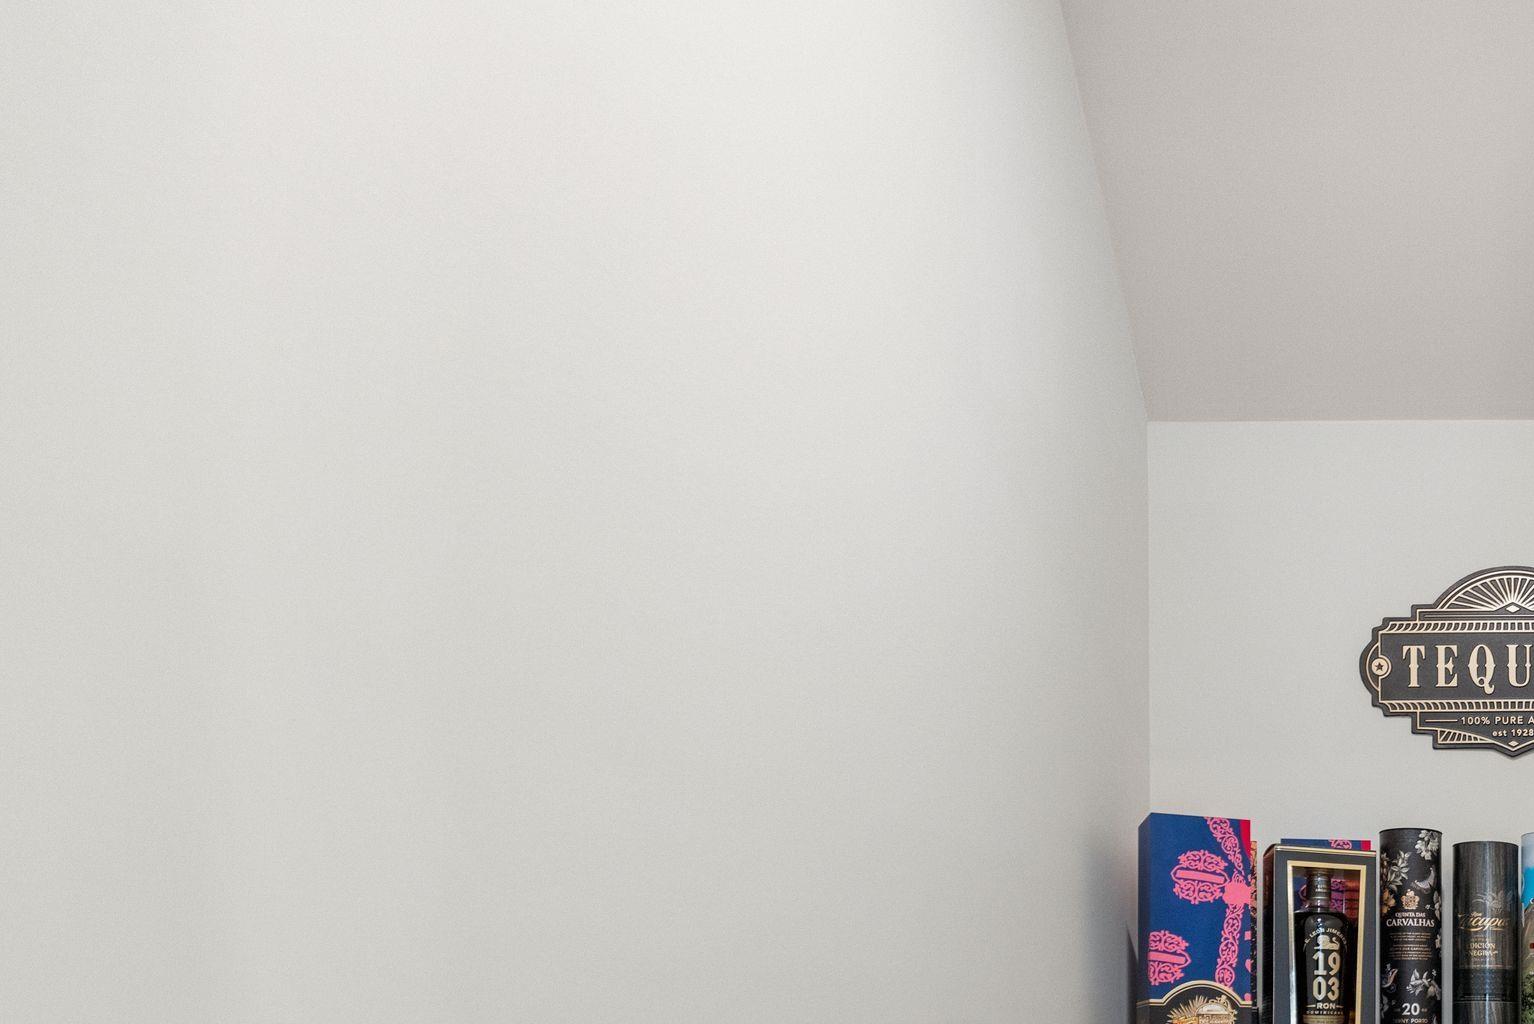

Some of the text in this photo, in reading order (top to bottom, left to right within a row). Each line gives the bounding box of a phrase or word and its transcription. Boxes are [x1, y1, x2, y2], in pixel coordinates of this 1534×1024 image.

[1460, 715, 1490, 725] 100%
[1495, 715, 1524, 725] PURE
[1492, 728, 1534, 737] est 1928
[1386, 918, 1435, 927] CARVALHAS
[1312, 951, 1341, 976] 19
[1312, 976, 1339, 1001] 03
[1402, 1003, 1420, 1015] 20
